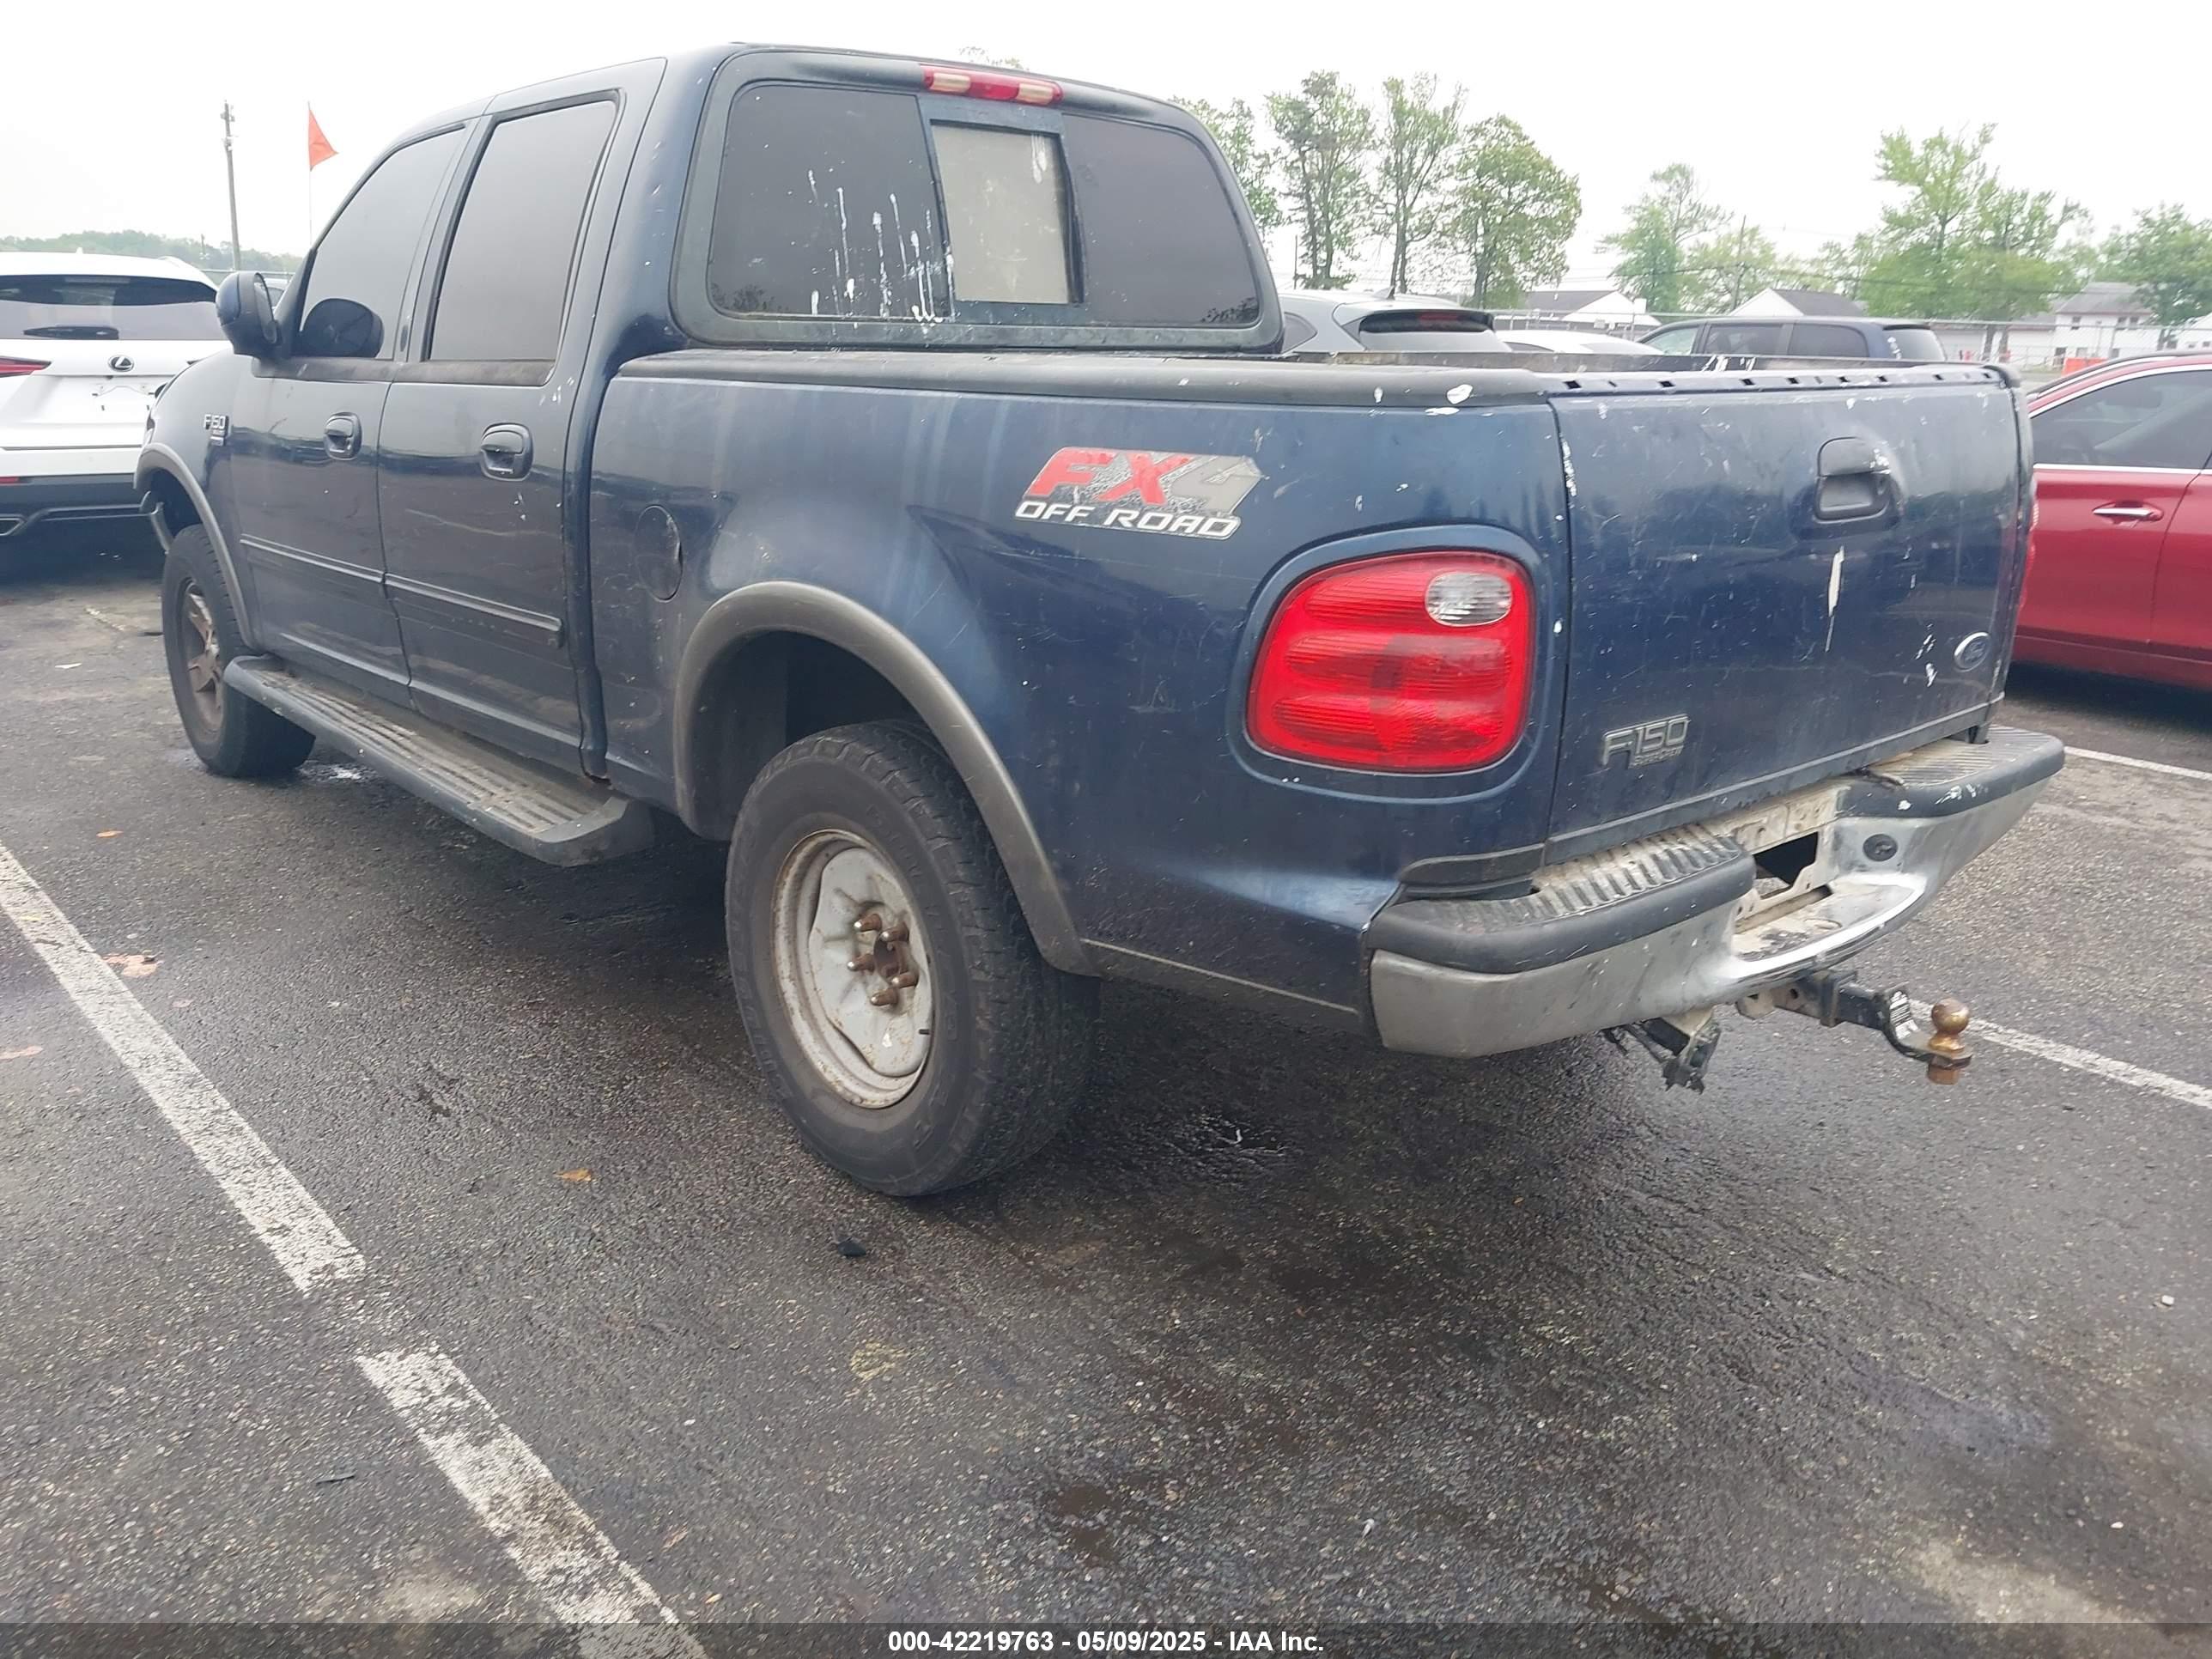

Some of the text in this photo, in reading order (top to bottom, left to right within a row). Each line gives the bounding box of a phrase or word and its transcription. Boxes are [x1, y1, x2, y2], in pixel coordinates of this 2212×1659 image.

[1022, 447, 1262, 515] FX4
[1014, 500, 1242, 538] OFF ROAD
[1602, 715, 1690, 767] F150
